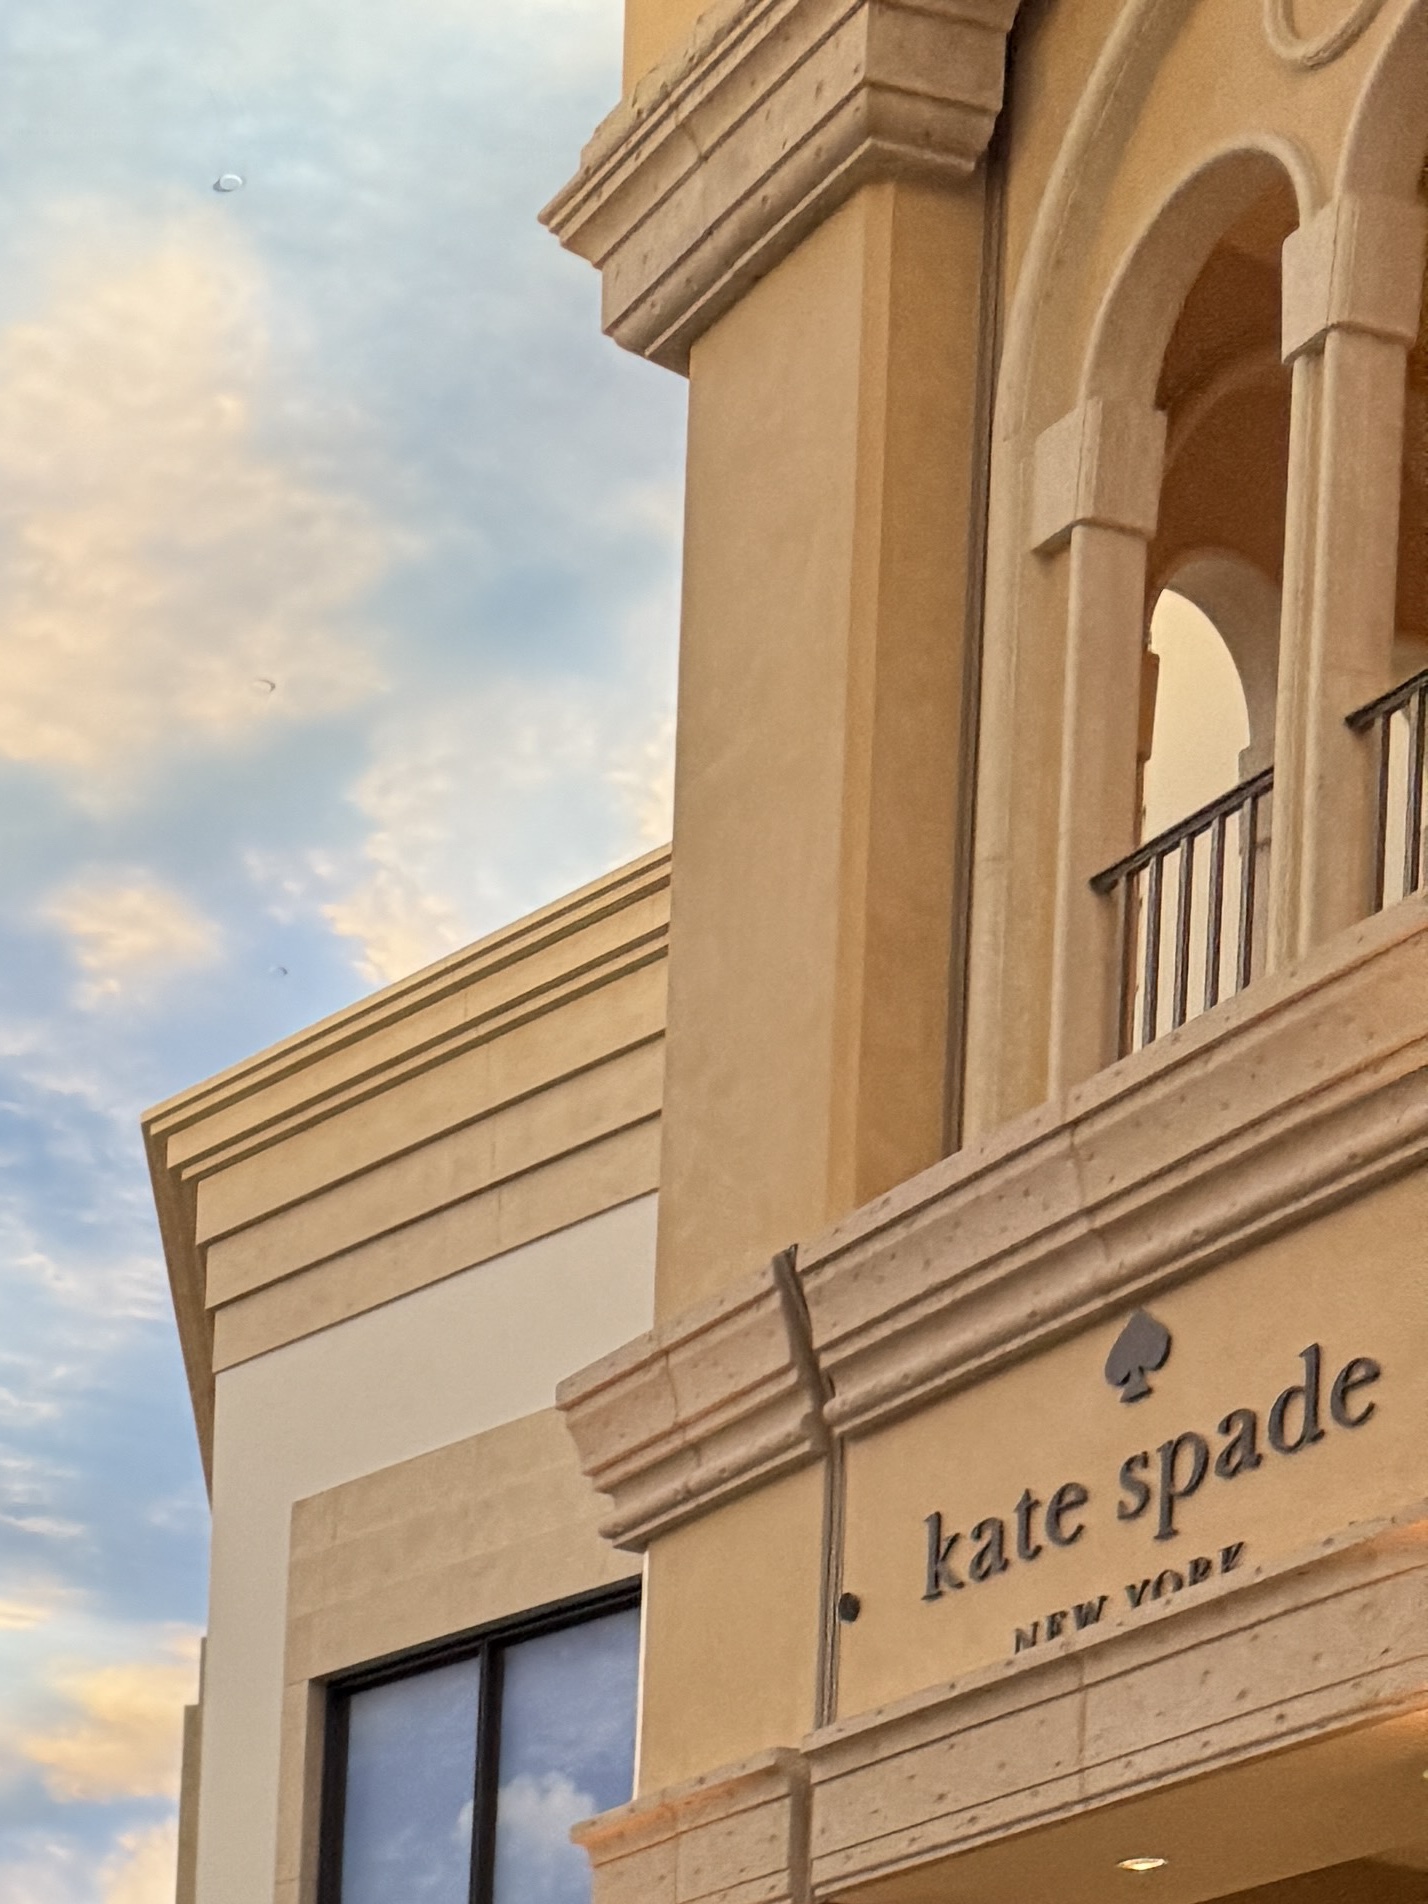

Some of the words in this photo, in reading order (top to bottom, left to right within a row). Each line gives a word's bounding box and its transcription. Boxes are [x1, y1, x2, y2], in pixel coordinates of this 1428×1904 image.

[921, 1482, 1090, 1602] kate
[1116, 1343, 1381, 1540] spade
[1013, 1595, 1108, 1655] NEW
[1125, 1542, 1246, 1608] YORK
